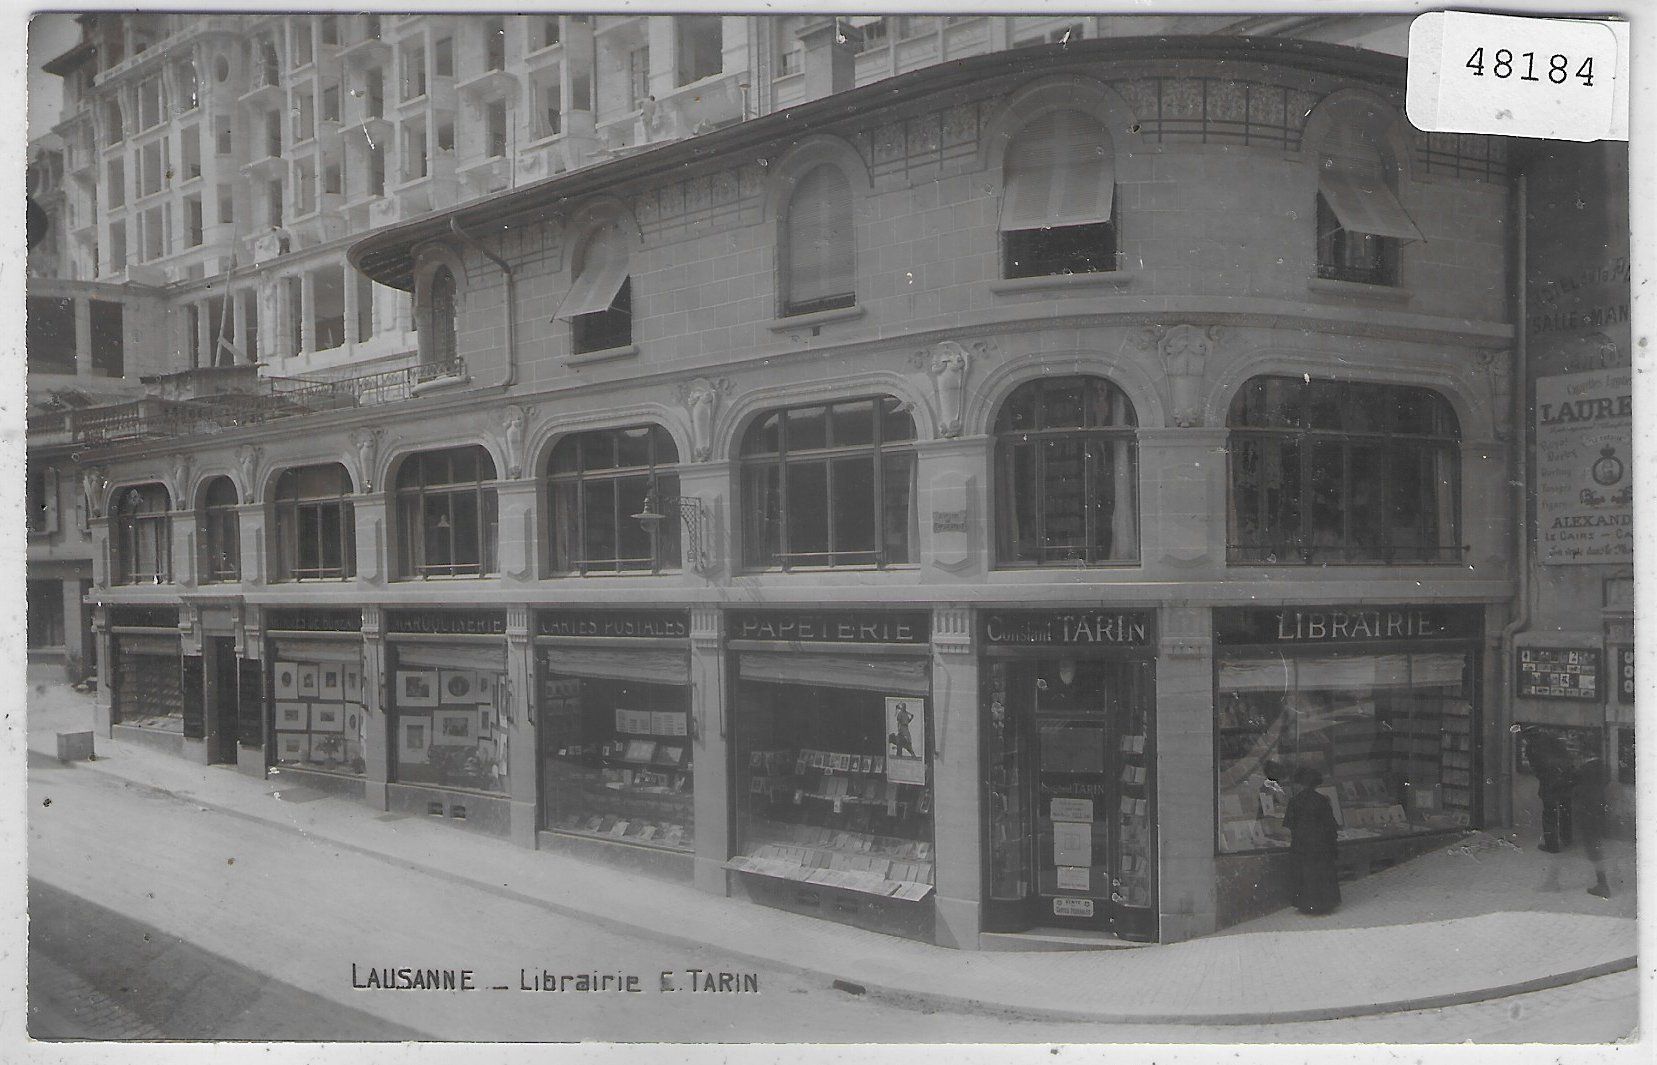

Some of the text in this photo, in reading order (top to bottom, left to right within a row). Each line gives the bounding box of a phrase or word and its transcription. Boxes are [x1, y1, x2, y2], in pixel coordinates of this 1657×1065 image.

[1466, 47, 1594, 86] 48184
[542, 619, 685, 635] CARTES POSTALES
[742, 618, 912, 640] PAPETERIE
[1060, 614, 1145, 642] TARIN
[1277, 611, 1433, 640] LIBRAIRIE
